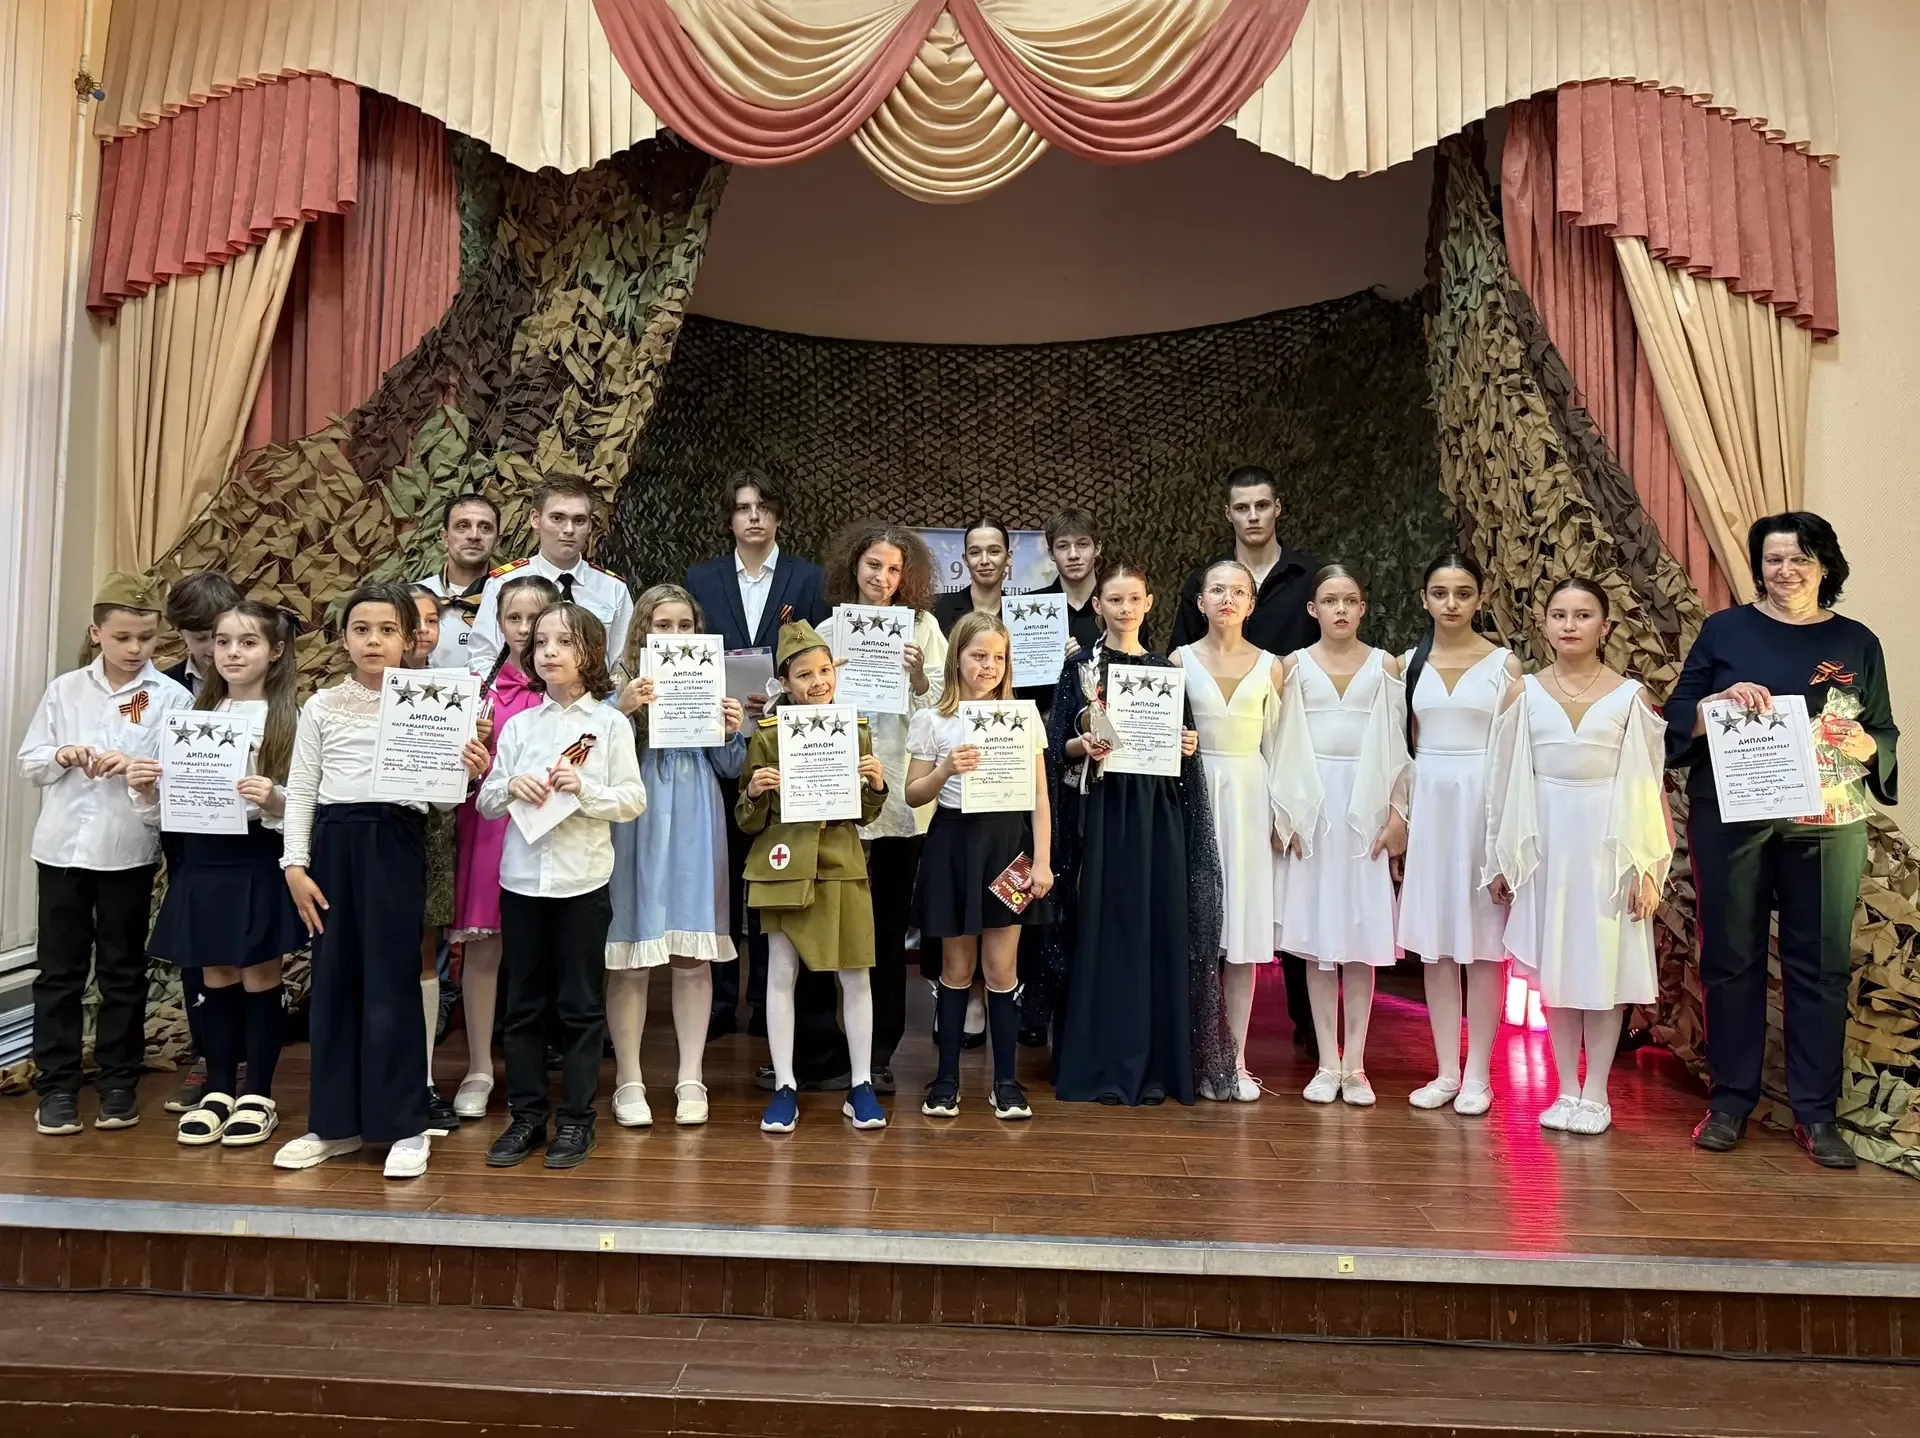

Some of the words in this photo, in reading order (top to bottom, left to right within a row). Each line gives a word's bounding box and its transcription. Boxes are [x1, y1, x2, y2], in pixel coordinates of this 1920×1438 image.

[950, 561, 963, 580] 9
[409, 714, 446, 722] ДИПЛОМ
[392, 722, 434, 730] НАГРАЖДАЕТСЯ
[1739, 736, 1774, 745] ДИПЛОМ
[1002, 881, 1015, 893] МАЯ
